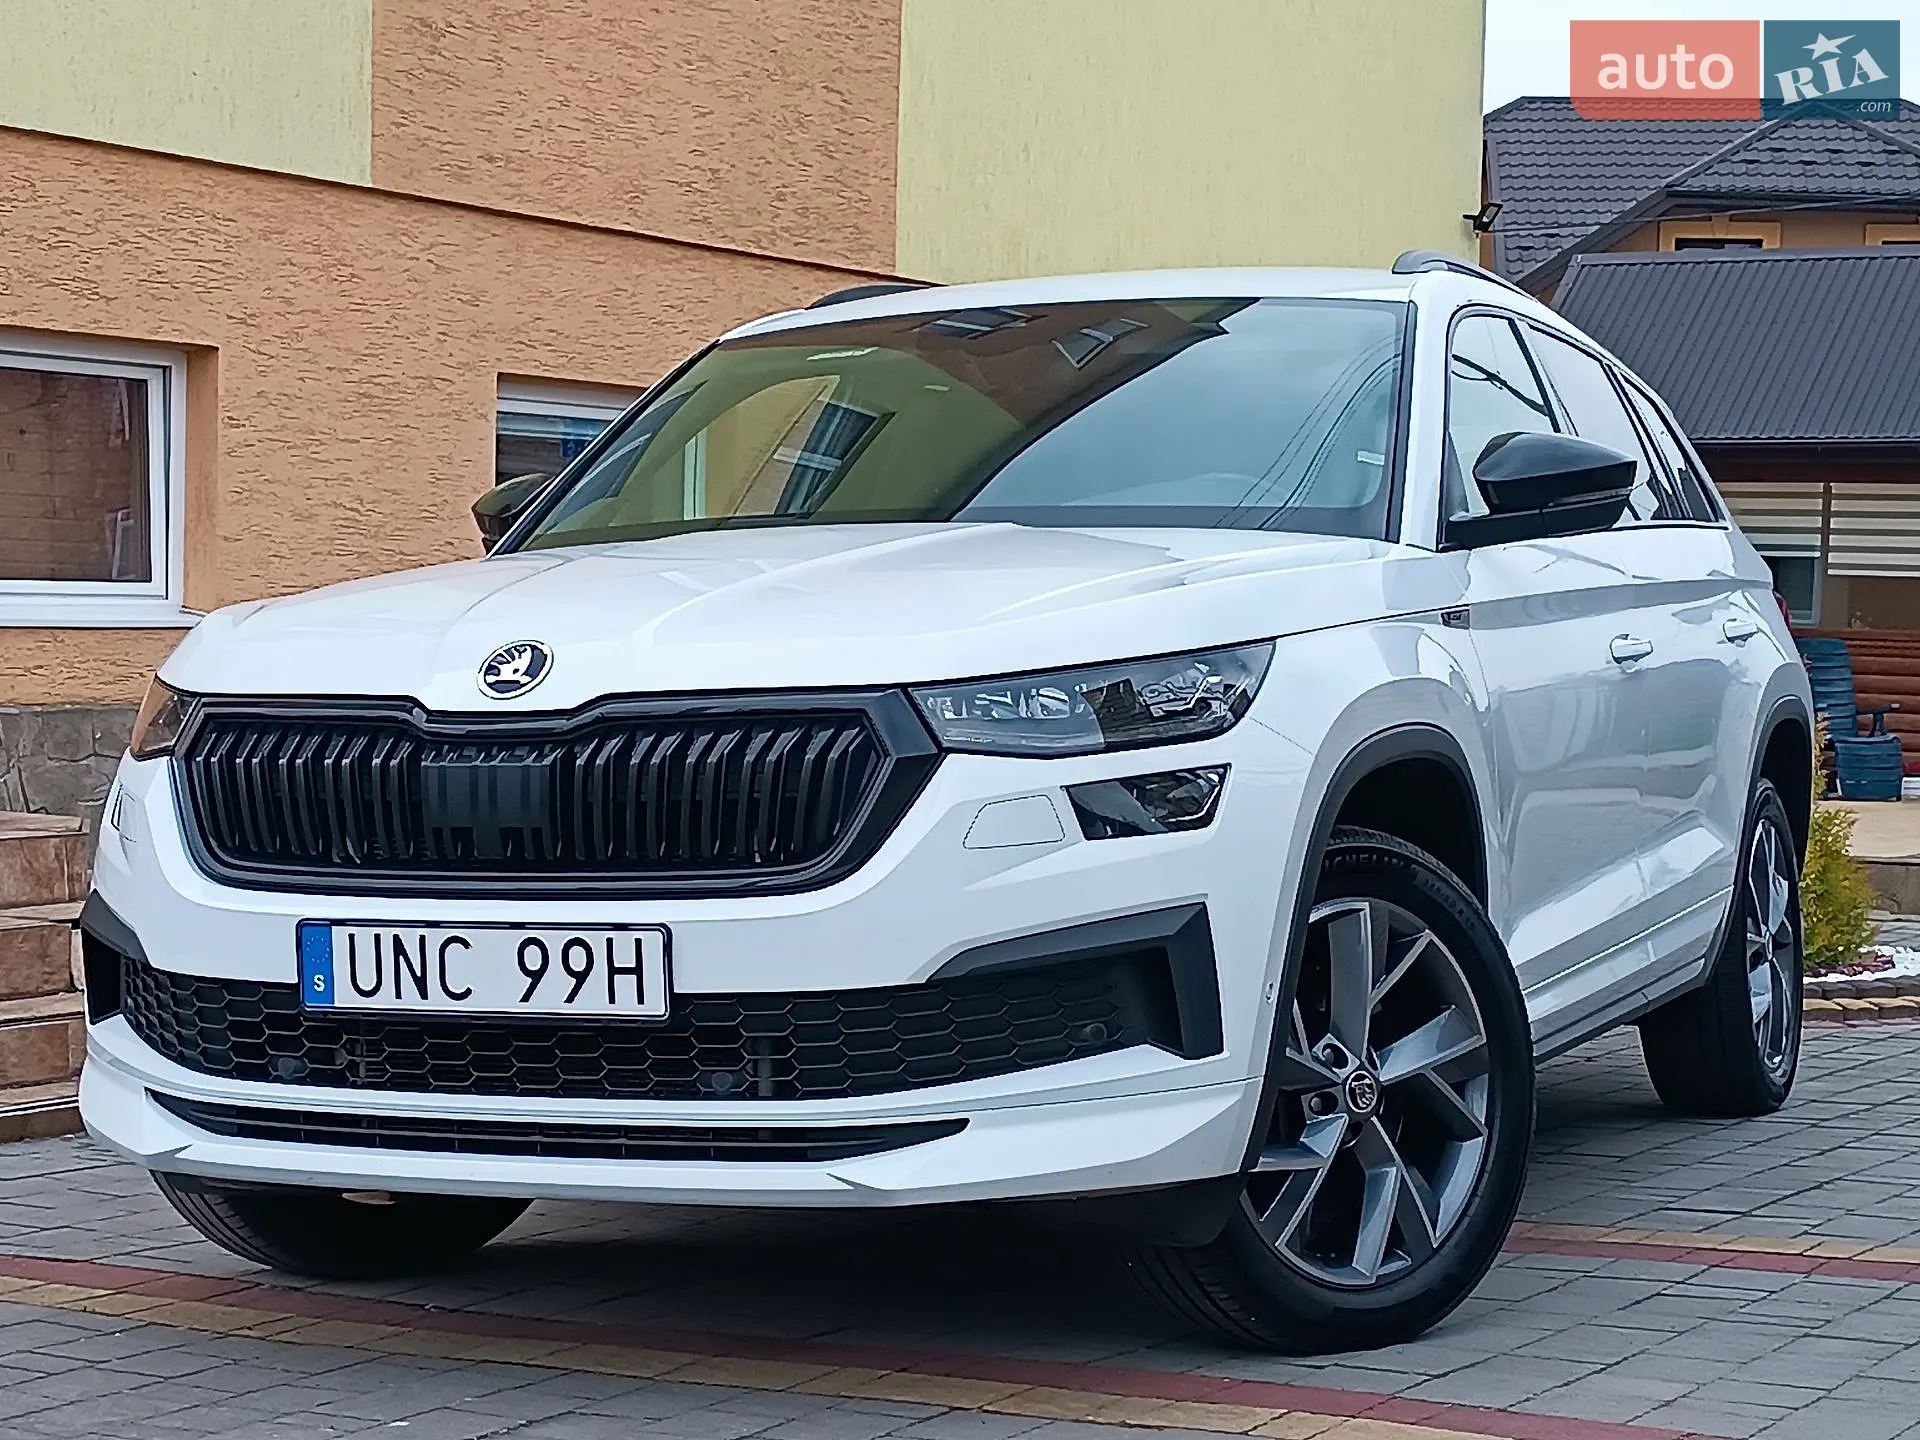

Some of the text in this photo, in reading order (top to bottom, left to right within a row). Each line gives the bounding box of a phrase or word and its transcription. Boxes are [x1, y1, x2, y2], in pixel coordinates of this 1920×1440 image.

[1324, 853, 1405, 873] ICHELIN
[348, 933, 645, 1005] UNC 99H
[313, 974, 325, 992] S
